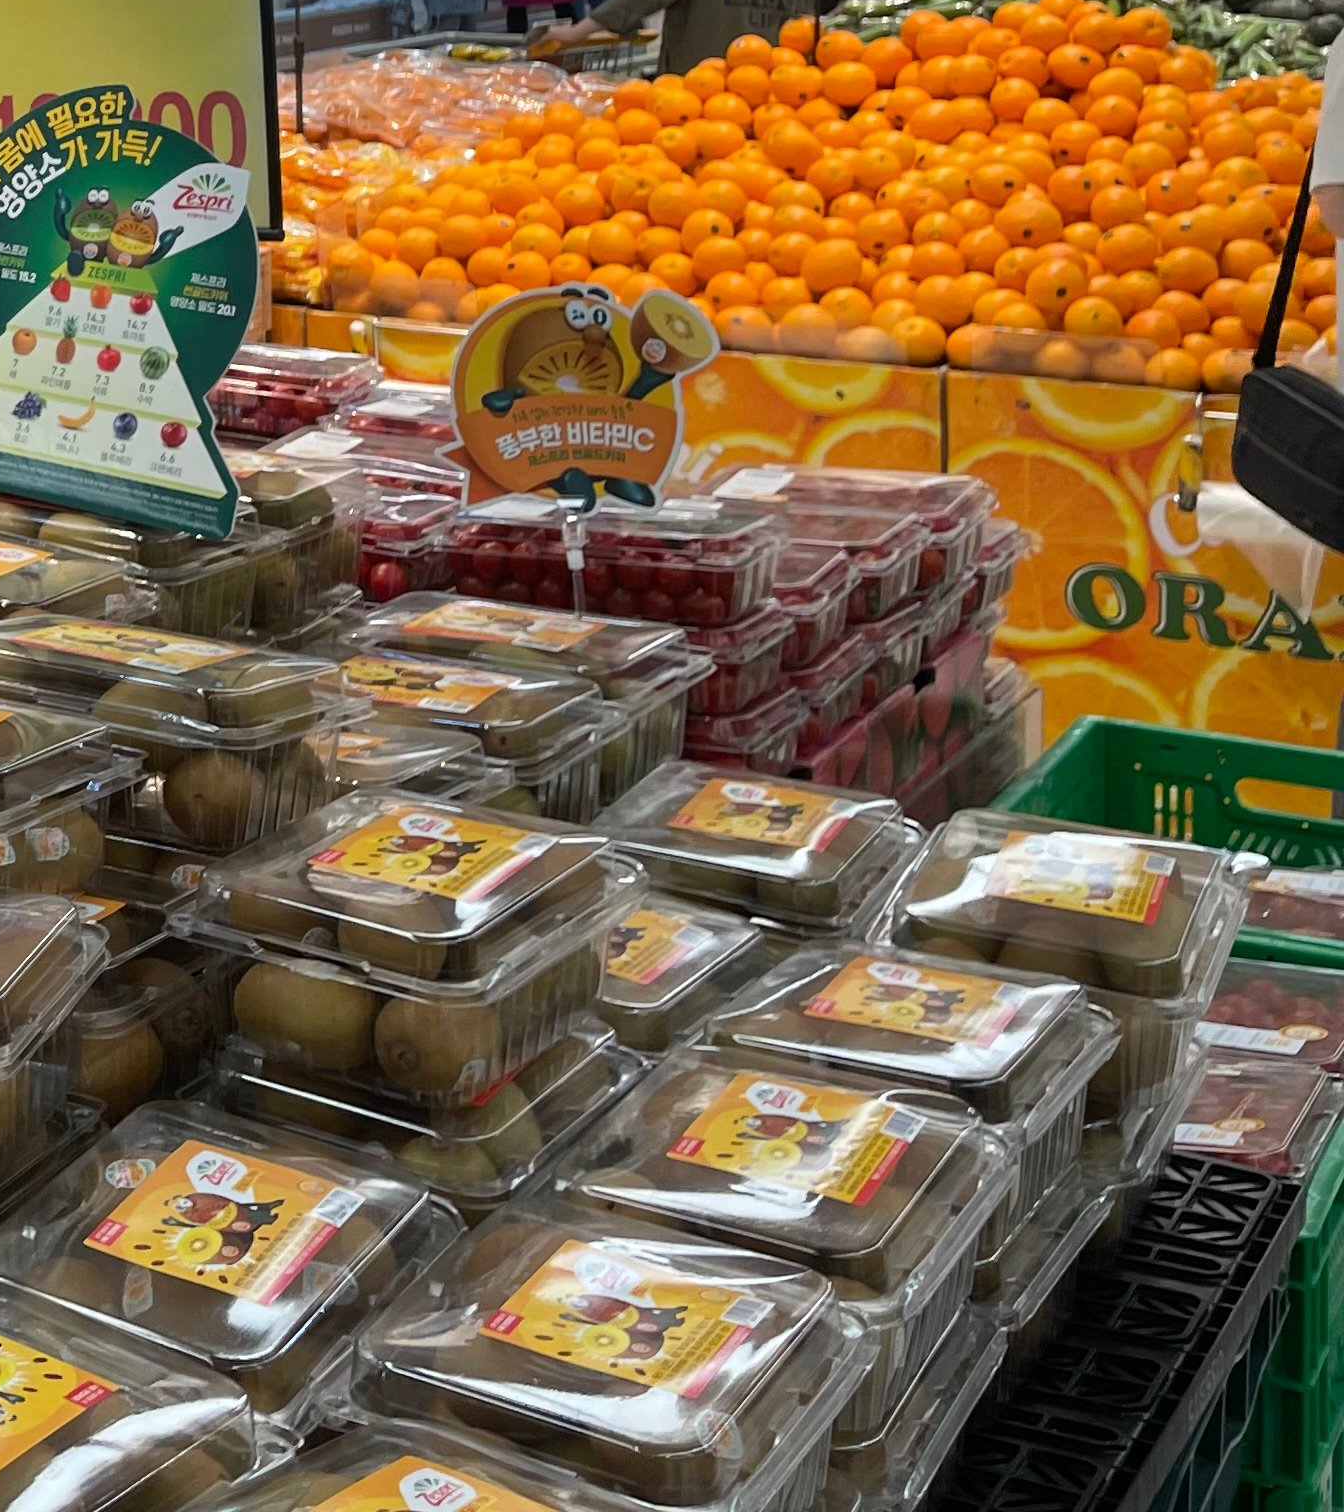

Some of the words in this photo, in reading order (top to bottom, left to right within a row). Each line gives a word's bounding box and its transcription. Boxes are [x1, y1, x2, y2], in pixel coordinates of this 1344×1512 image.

[46, 91, 127, 139] 필요한
[96, 129, 162, 166] 가득!
[173, 184, 233, 213] Zespri
[88, 265, 126, 283] ZESPRI
[190, 272, 226, 287] 제스프리
[48, 306, 62, 317] 9.6
[86, 312, 106, 324] 14.3
[127, 319, 147, 331] 14.7
[13, 359, 19, 368] 7
[51, 366, 66, 377] 7.2
[95, 374, 110, 386] 7.3
[139, 383, 155, 394] 8.9
[15, 422, 30, 434] 3.6
[62, 433, 77, 443] 4.1
[495, 425, 562, 461] 풍부한
[567, 421, 655, 452] 비타민C
[110, 443, 127, 454] 4.3
[160, 452, 176, 464] 6.6
[1065, 562, 1338, 661] ORA
